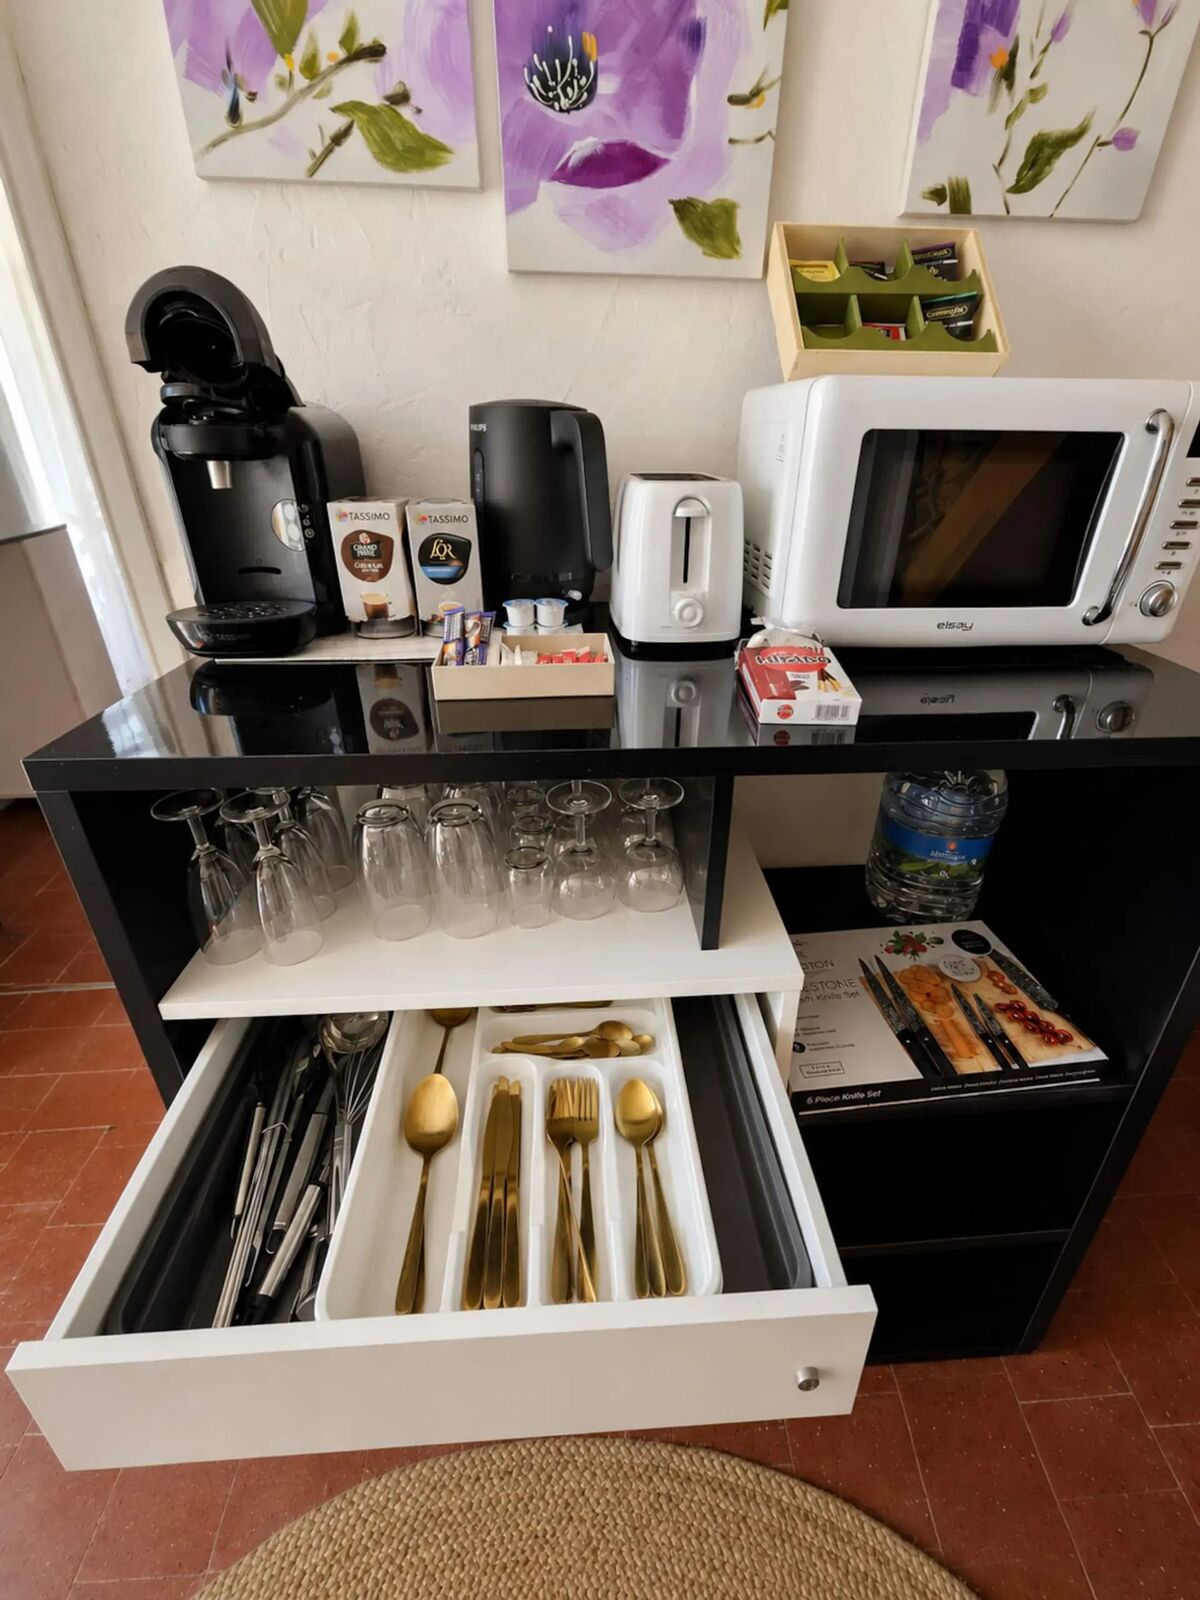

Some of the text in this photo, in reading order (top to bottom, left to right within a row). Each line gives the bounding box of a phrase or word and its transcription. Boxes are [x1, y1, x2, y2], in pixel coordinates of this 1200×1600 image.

[348, 511, 391, 521] TASSIMO
[427, 514, 469, 524] TASSIMO
[936, 621, 974, 632] elsay
[806, 1089, 882, 1105] 6 Piece Knife Set
